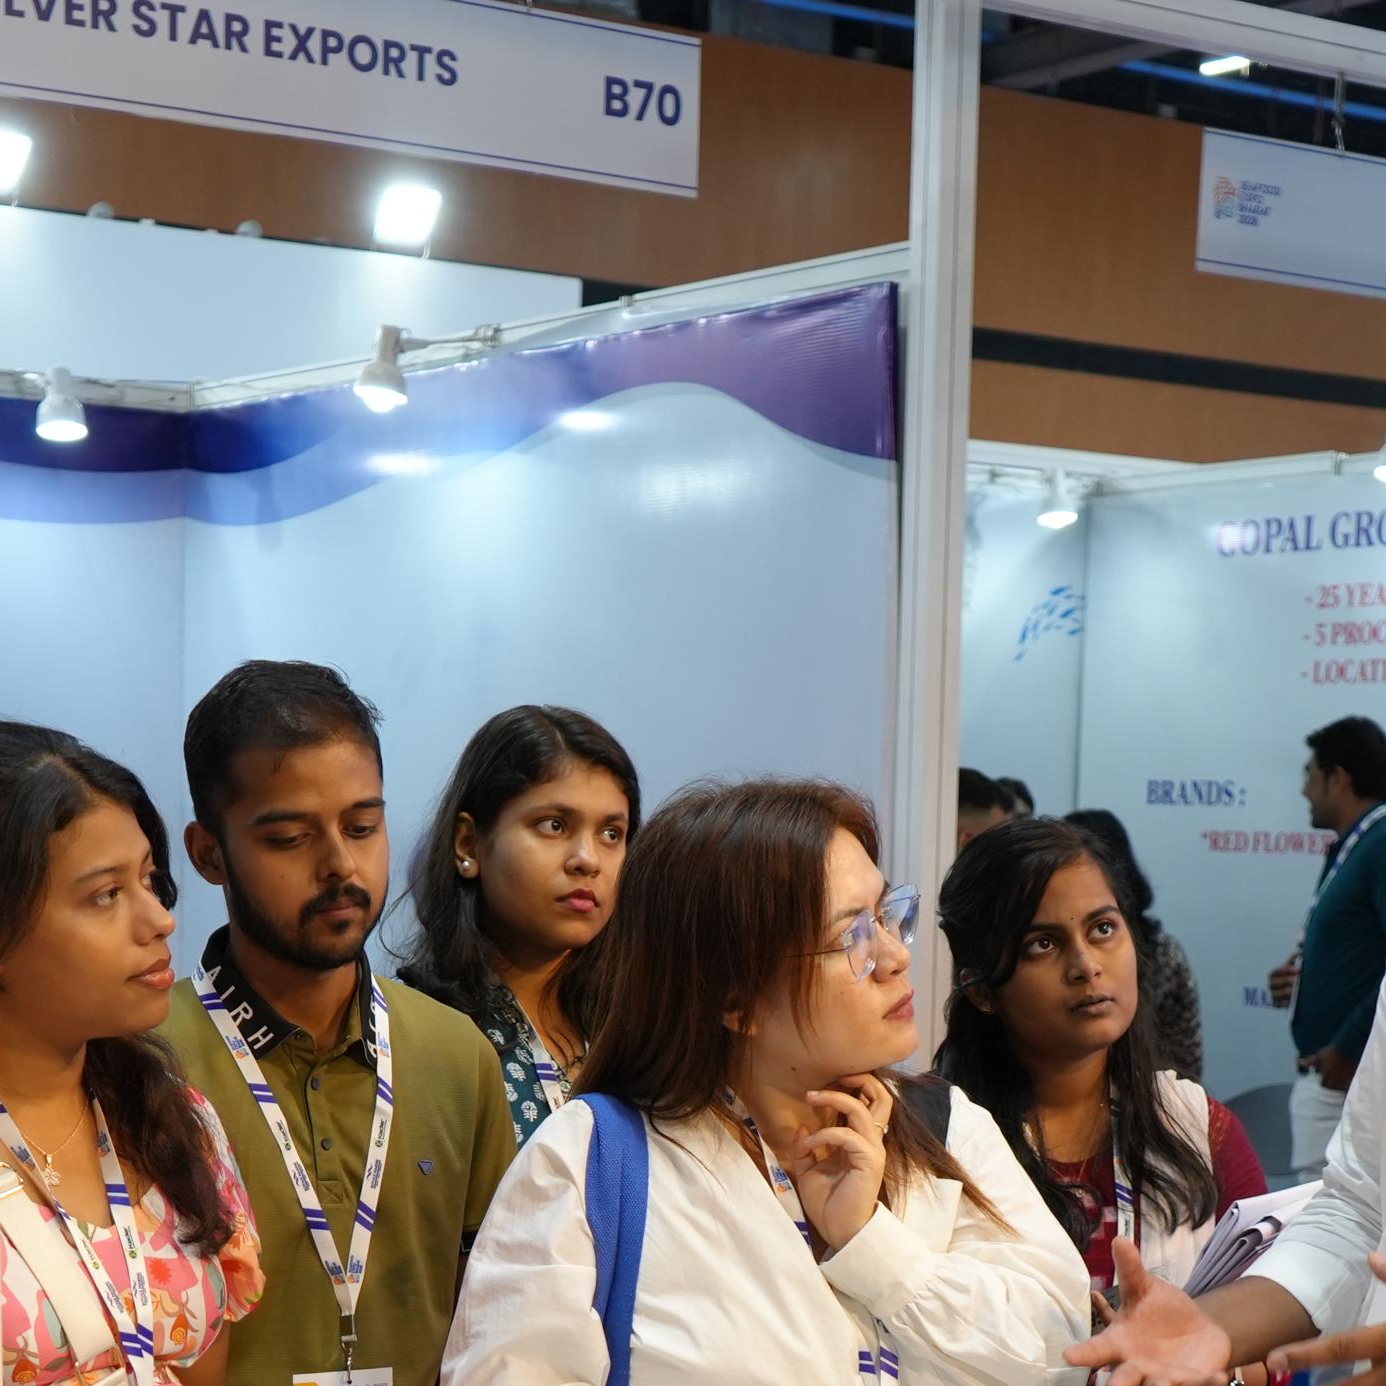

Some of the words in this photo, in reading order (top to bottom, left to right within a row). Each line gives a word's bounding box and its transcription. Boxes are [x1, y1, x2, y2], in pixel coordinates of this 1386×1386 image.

[131, 0, 250, 54] STAR
[264, 18, 459, 87] EXPORTS
[603, 75, 682, 127] B70
[1317, 585, 1341, 609] 25
[1316, 623, 1327, 646] 5
